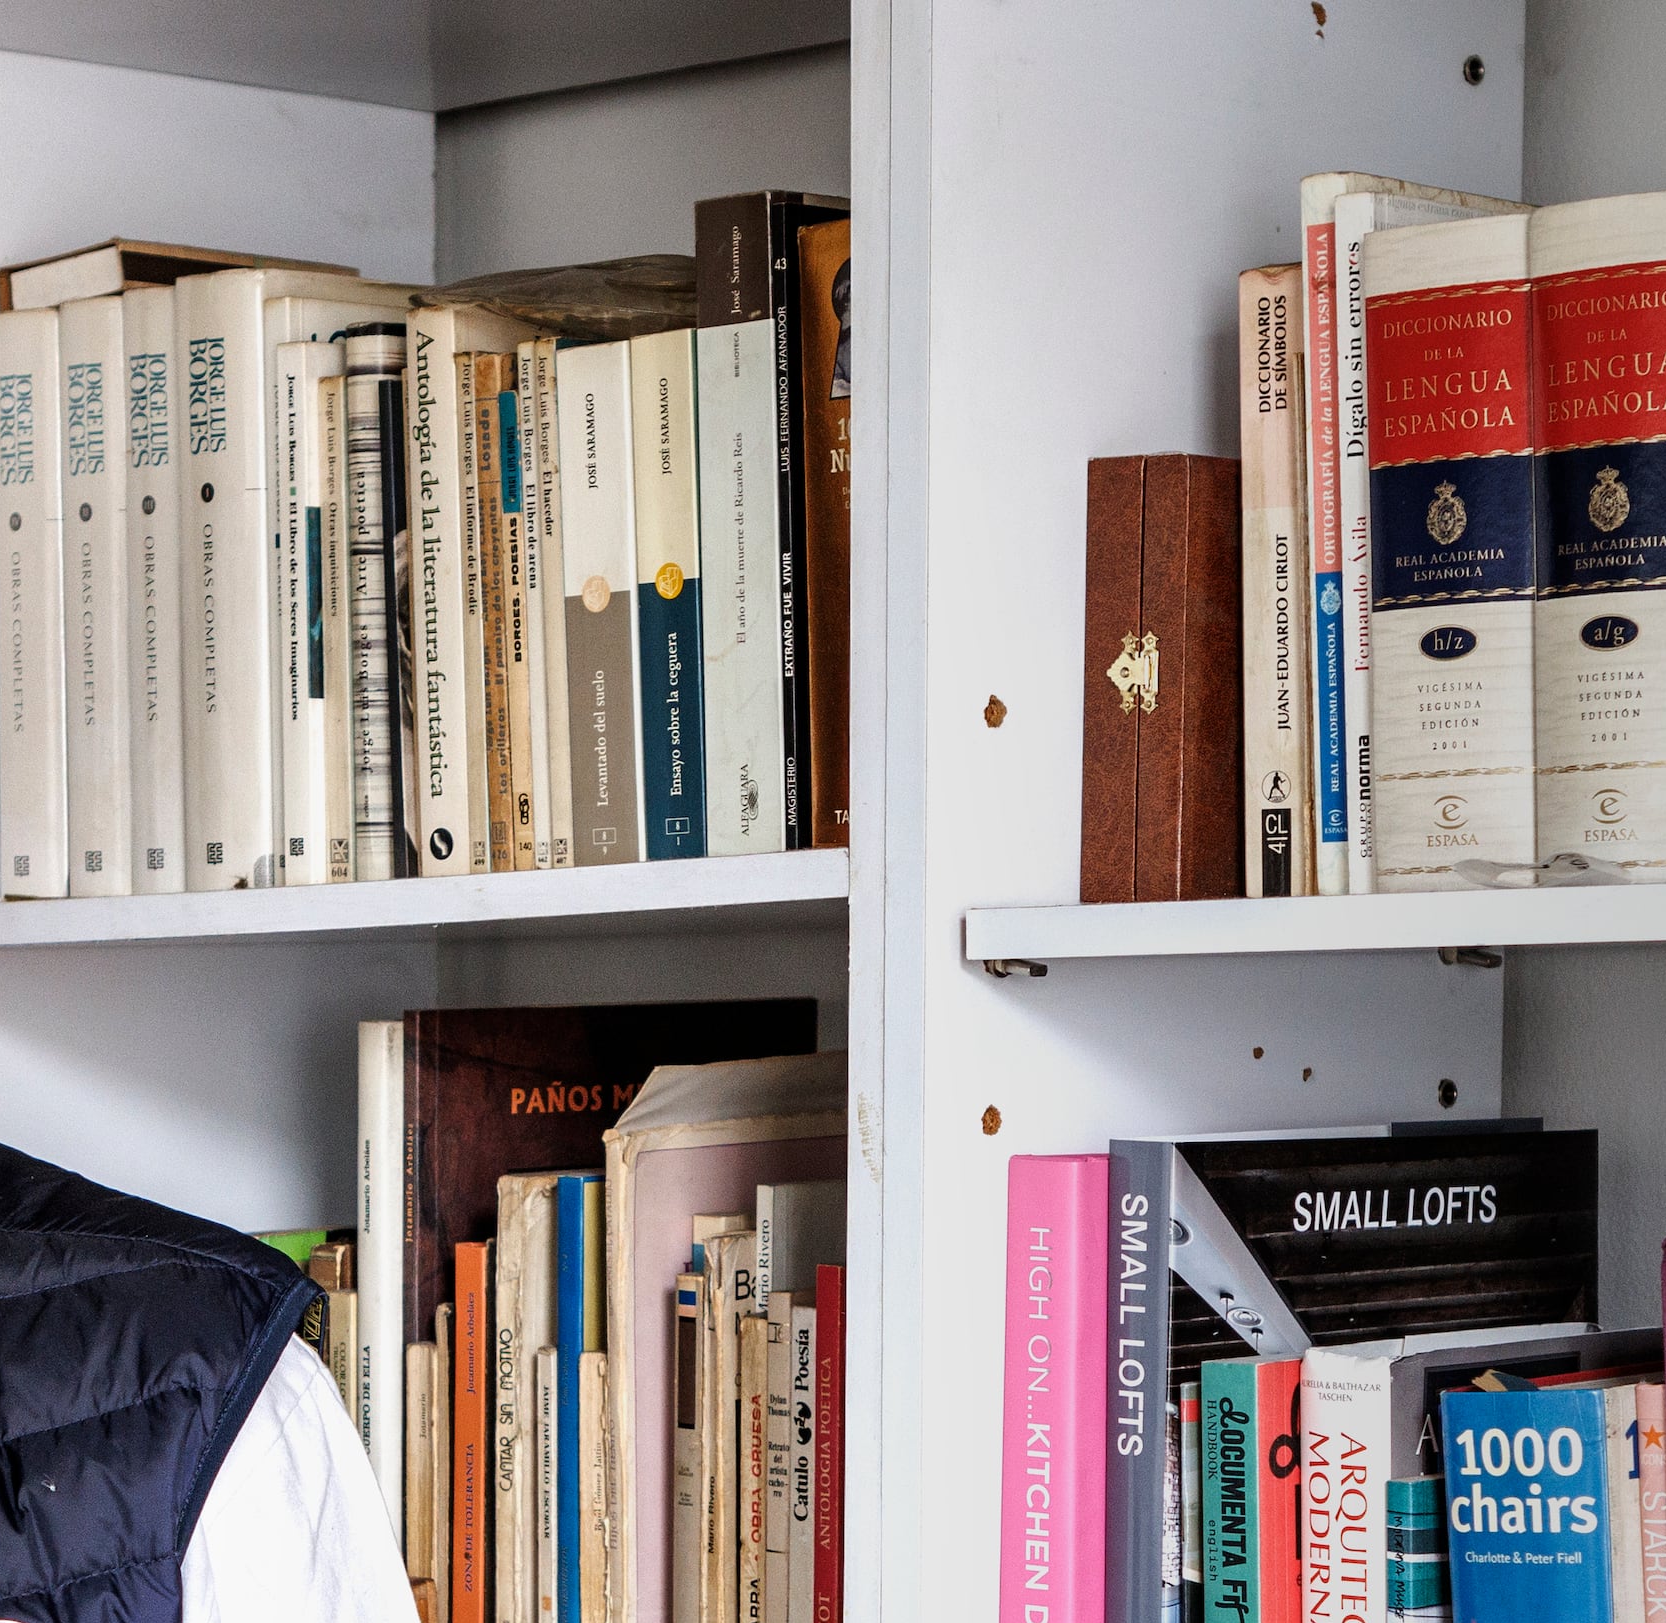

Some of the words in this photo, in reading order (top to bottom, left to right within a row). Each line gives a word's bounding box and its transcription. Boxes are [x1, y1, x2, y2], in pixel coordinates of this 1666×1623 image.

[1347, 242, 1362, 329] errores
[1274, 295, 1287, 383] SÍMBOLOS
[1383, 308, 1512, 339] DICCIONARIO
[207, 337, 225, 404] JORGE
[1258, 296, 1271, 413] DICCIONARIO
[1345, 336, 1363, 371] sin
[189, 337, 208, 455] BORGES
[412, 331, 436, 464] Antología
[1275, 389, 1287, 410] DE
[1384, 369, 1512, 403] LENGUA
[210, 407, 226, 452] LUIS
[583, 393, 596, 456] SARAMAGO
[1345, 378, 1367, 459] Dígalo
[1383, 404, 1516, 439] ESPAÑOLA
[421, 470, 440, 500] de
[588, 460, 598, 489] JOSÉ
[422, 506, 440, 536] la
[203, 523, 214, 587] OBRAS
[782, 552, 791, 584] VIVIR
[1276, 534, 1289, 591] CIRLOT
[1395, 553, 1425, 568] REAL
[1430, 548, 1505, 565] ACADEMIA
[1414, 563, 1483, 581] ESPAÑOLA
[422, 538, 443, 665] literatura
[784, 592, 792, 615] FUE
[204, 594, 216, 713] COMPLETAS
[668, 631, 681, 686] ceguera
[784, 619, 795, 677] EXTRAÑO
[1432, 631, 1465, 653] h/z
[666, 689, 679, 703] la
[1417, 680, 1483, 694] VIGÉSIMA
[1419, 699, 1482, 713] SEGUNDA
[427, 668, 448, 798] fantástica
[667, 706, 680, 746] sobre
[1421, 716, 1480, 731] EDICIÓN
[1432, 739, 1469, 751] 2001
[670, 749, 684, 796] Ensayo
[787, 757, 797, 825] MAGISTERIO
[740, 764, 750, 836] ALFAGUARA
[1427, 832, 1479, 848] ESPASA
[510, 1081, 604, 1116] PAÑOS
[1292, 1184, 1396, 1234] SMALL
[1406, 1183, 1499, 1230] LOFTS
[795, 1328, 811, 1392] Poesía
[1455, 1427, 1586, 1477] 1000
[794, 1455, 810, 1521] Catulo
[1451, 1489, 1599, 1535] chairs
[1465, 1550, 1511, 1566] Charlotte
[1526, 1552, 1553, 1566] Peter
[1557, 1550, 1582, 1566] Fiell
